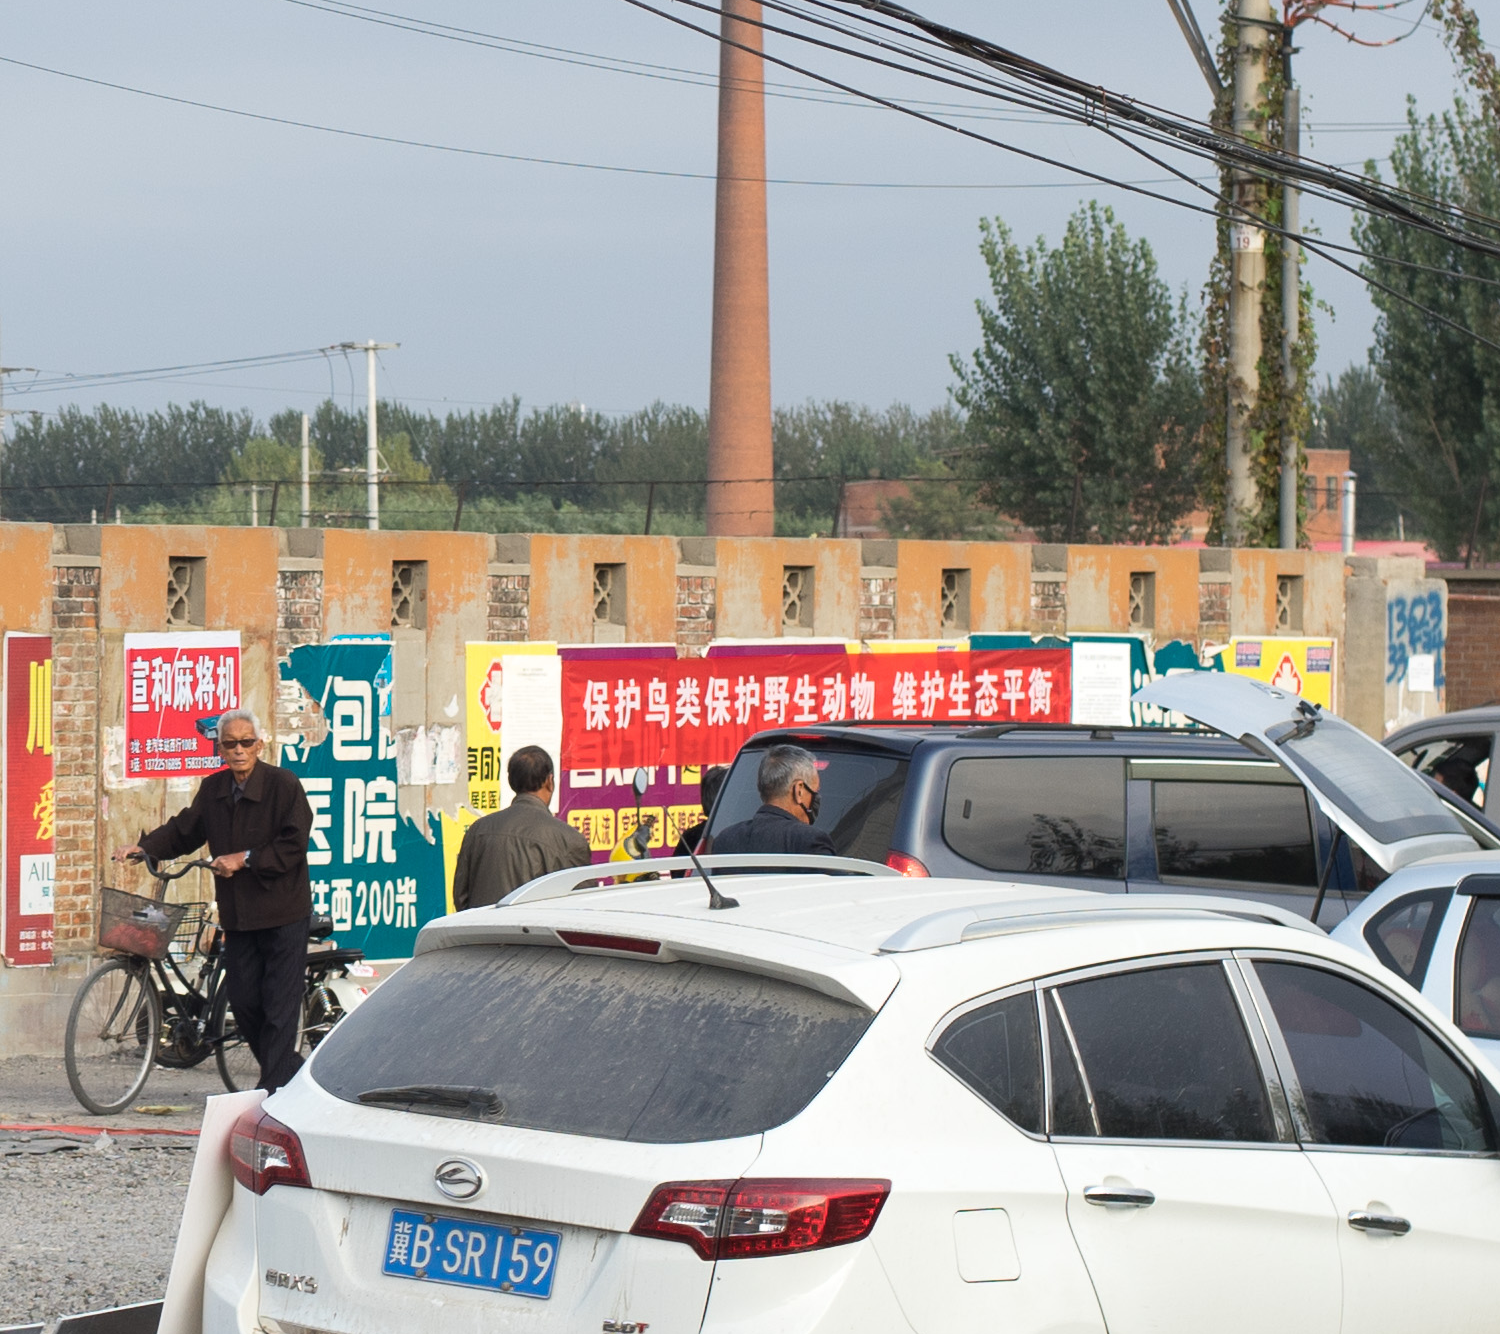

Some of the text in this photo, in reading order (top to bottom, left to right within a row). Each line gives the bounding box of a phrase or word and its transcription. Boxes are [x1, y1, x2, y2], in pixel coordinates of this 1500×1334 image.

[131, 655, 237, 713] 宣和麻将机
[583, 672, 875, 731] 保护鸟类保护野生动物
[892, 667, 1053, 720] 维护生态平衡
[388, 1220, 555, 1286] 冀B·SR159
